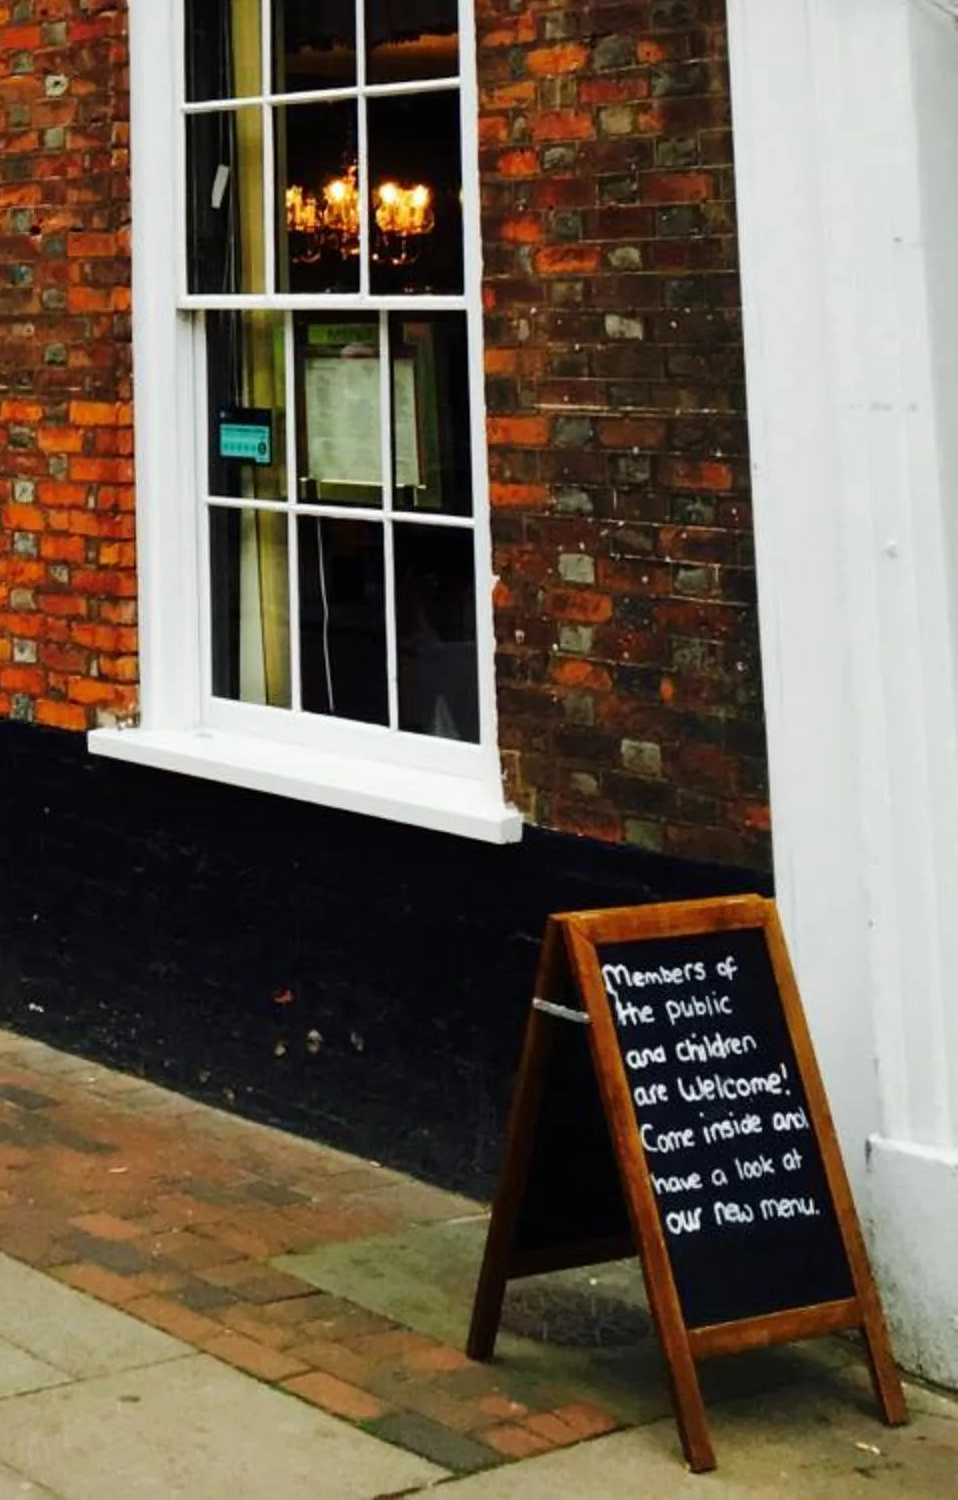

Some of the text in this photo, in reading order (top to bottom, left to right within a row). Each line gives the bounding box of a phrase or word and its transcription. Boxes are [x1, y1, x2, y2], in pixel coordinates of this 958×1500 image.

[602, 956, 738, 994] Members of
[616, 991, 733, 1026] the public
[626, 1046, 667, 1069] and
[634, 1084, 668, 1106] are
[640, 1107, 809, 1154] Come inside and
[652, 1148, 803, 1195] have a look at
[666, 1198, 820, 1235] our new menu.
